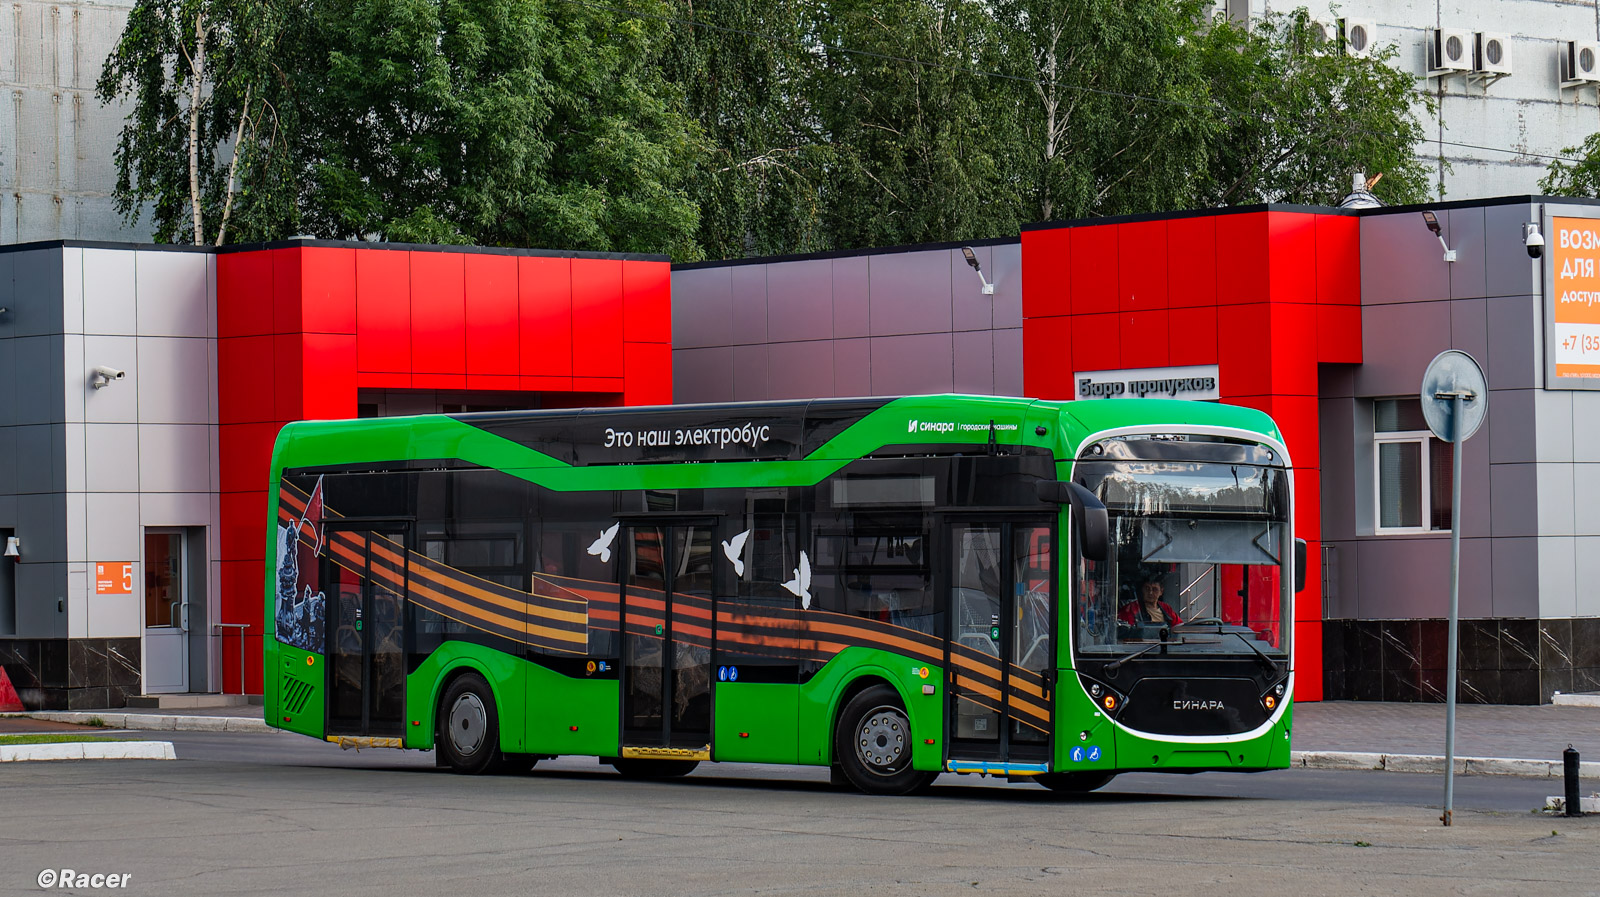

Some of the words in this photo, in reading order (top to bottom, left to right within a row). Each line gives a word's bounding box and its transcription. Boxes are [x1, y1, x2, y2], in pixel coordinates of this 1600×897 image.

[1560, 257, 1594, 279] ДЛЯ
[1562, 335, 1577, 350] +7
[1581, 333, 1600, 354] (35
[1079, 379, 1125, 398] Бюро
[1128, 377, 1215, 397] пропусков
[604, 428, 633, 447] Это
[637, 429, 671, 446] наш
[674, 422, 770, 449] электробус
[919, 422, 955, 434] синара
[122, 565, 132, 591] 5
[1173, 700, 1225, 710] СИНАРА
